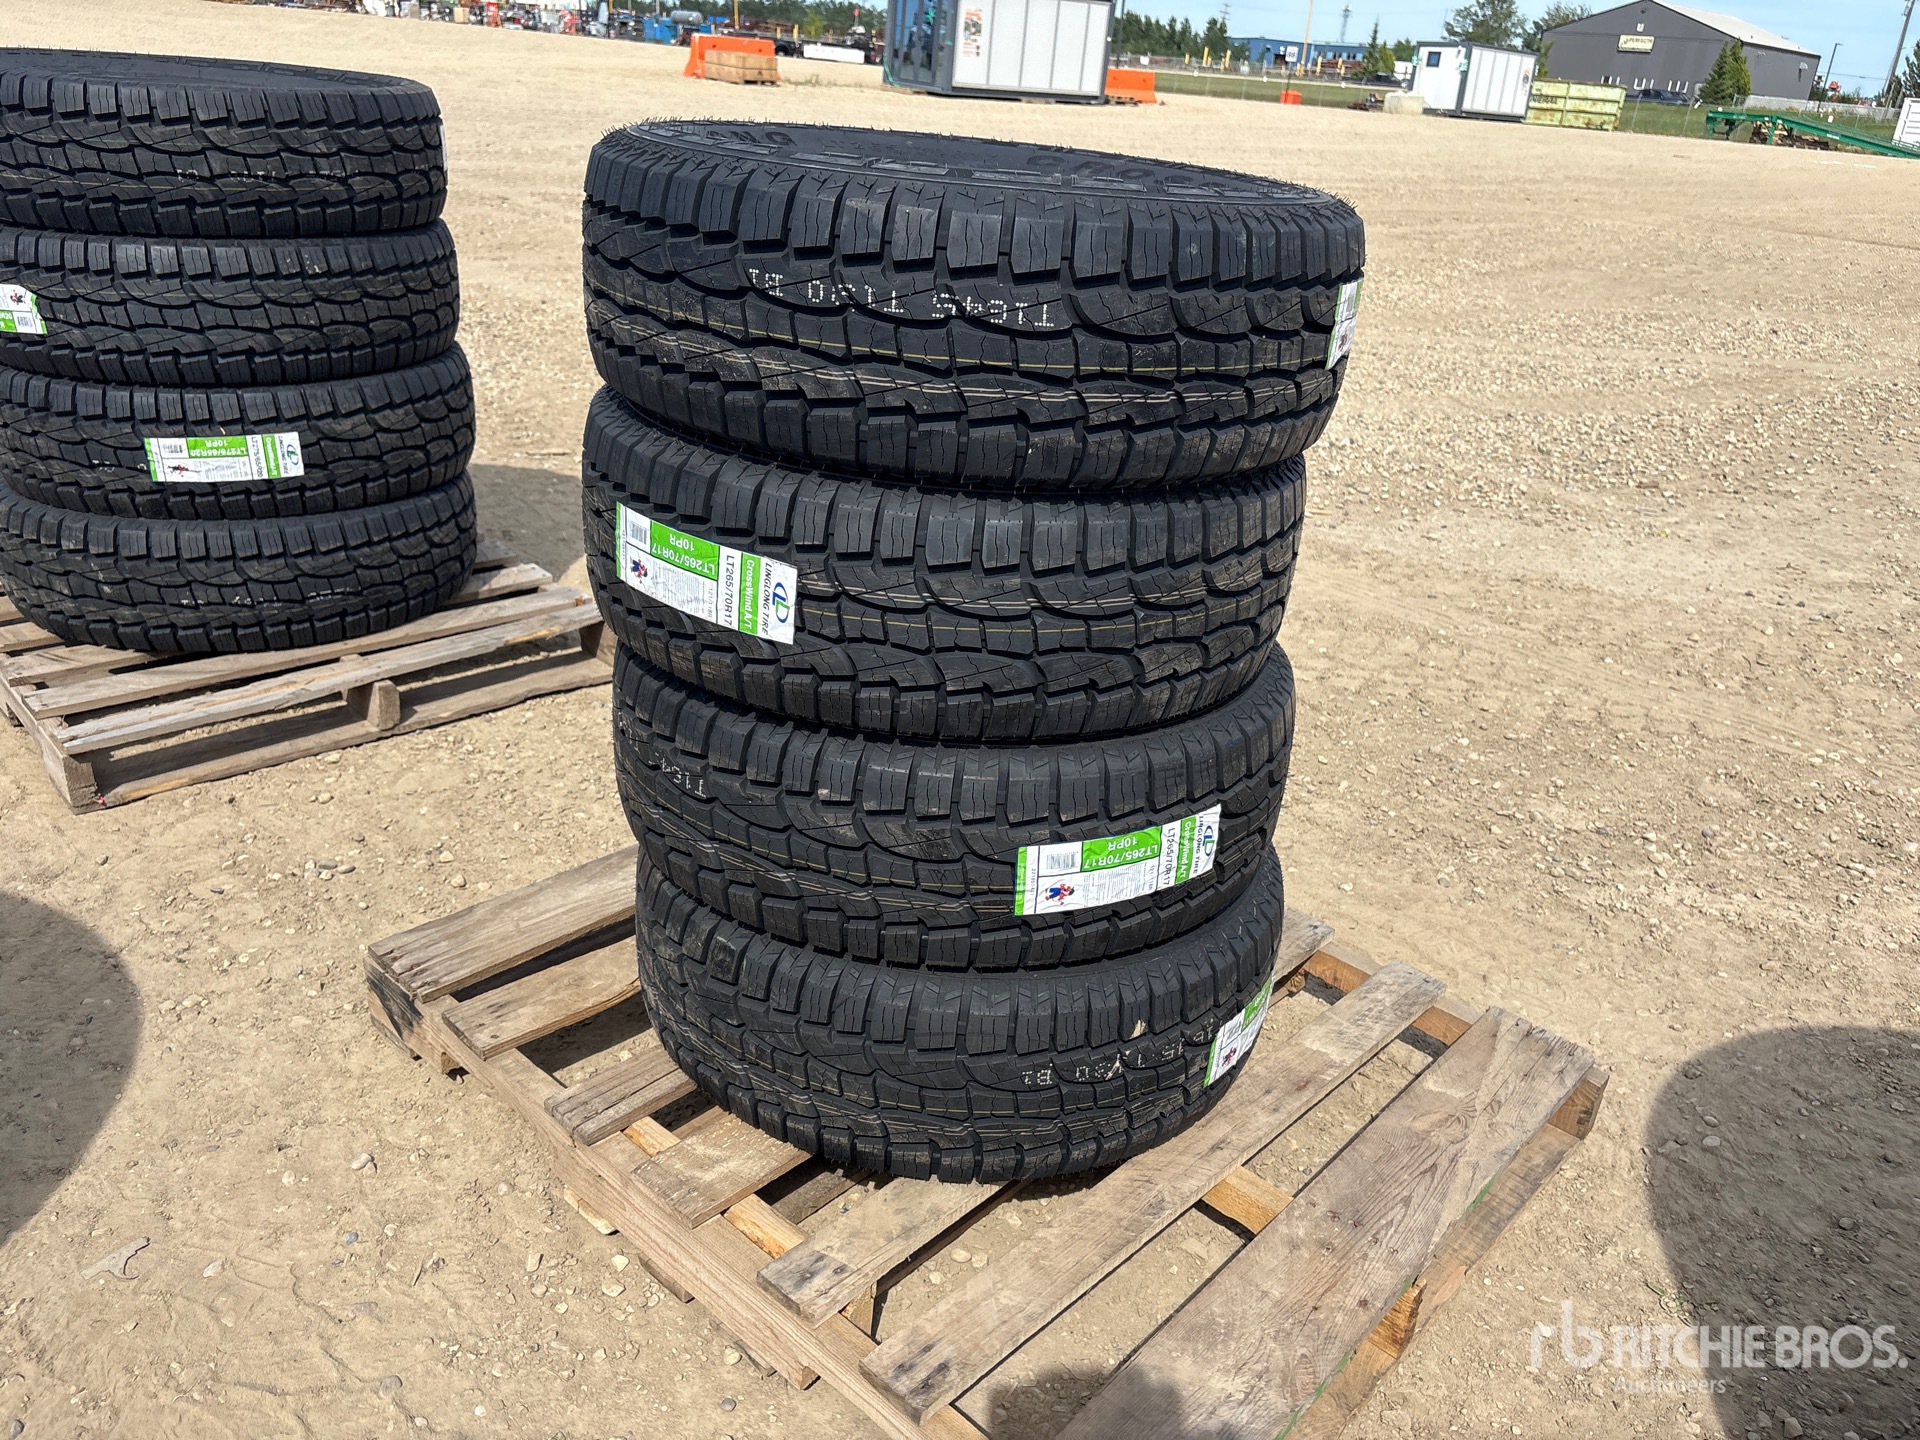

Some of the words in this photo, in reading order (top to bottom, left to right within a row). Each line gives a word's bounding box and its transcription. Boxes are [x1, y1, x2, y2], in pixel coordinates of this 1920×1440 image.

[650, 542, 717, 576] LT265/70R17
[669, 532, 695, 552] 10PR
[724, 554, 736, 626] LT265/70R17
[744, 559, 755, 611] CrossWind
[762, 562, 773, 612] LINGLONG
[744, 610, 753, 630] A/T
[761, 611, 770, 636] TIRE
[1107, 835, 1138, 851] 10PR
[1195, 815, 1204, 855] LINGLONG
[1083, 844, 1158, 870] LT265/70R17
[1163, 827, 1176, 886] LT265/70R17
